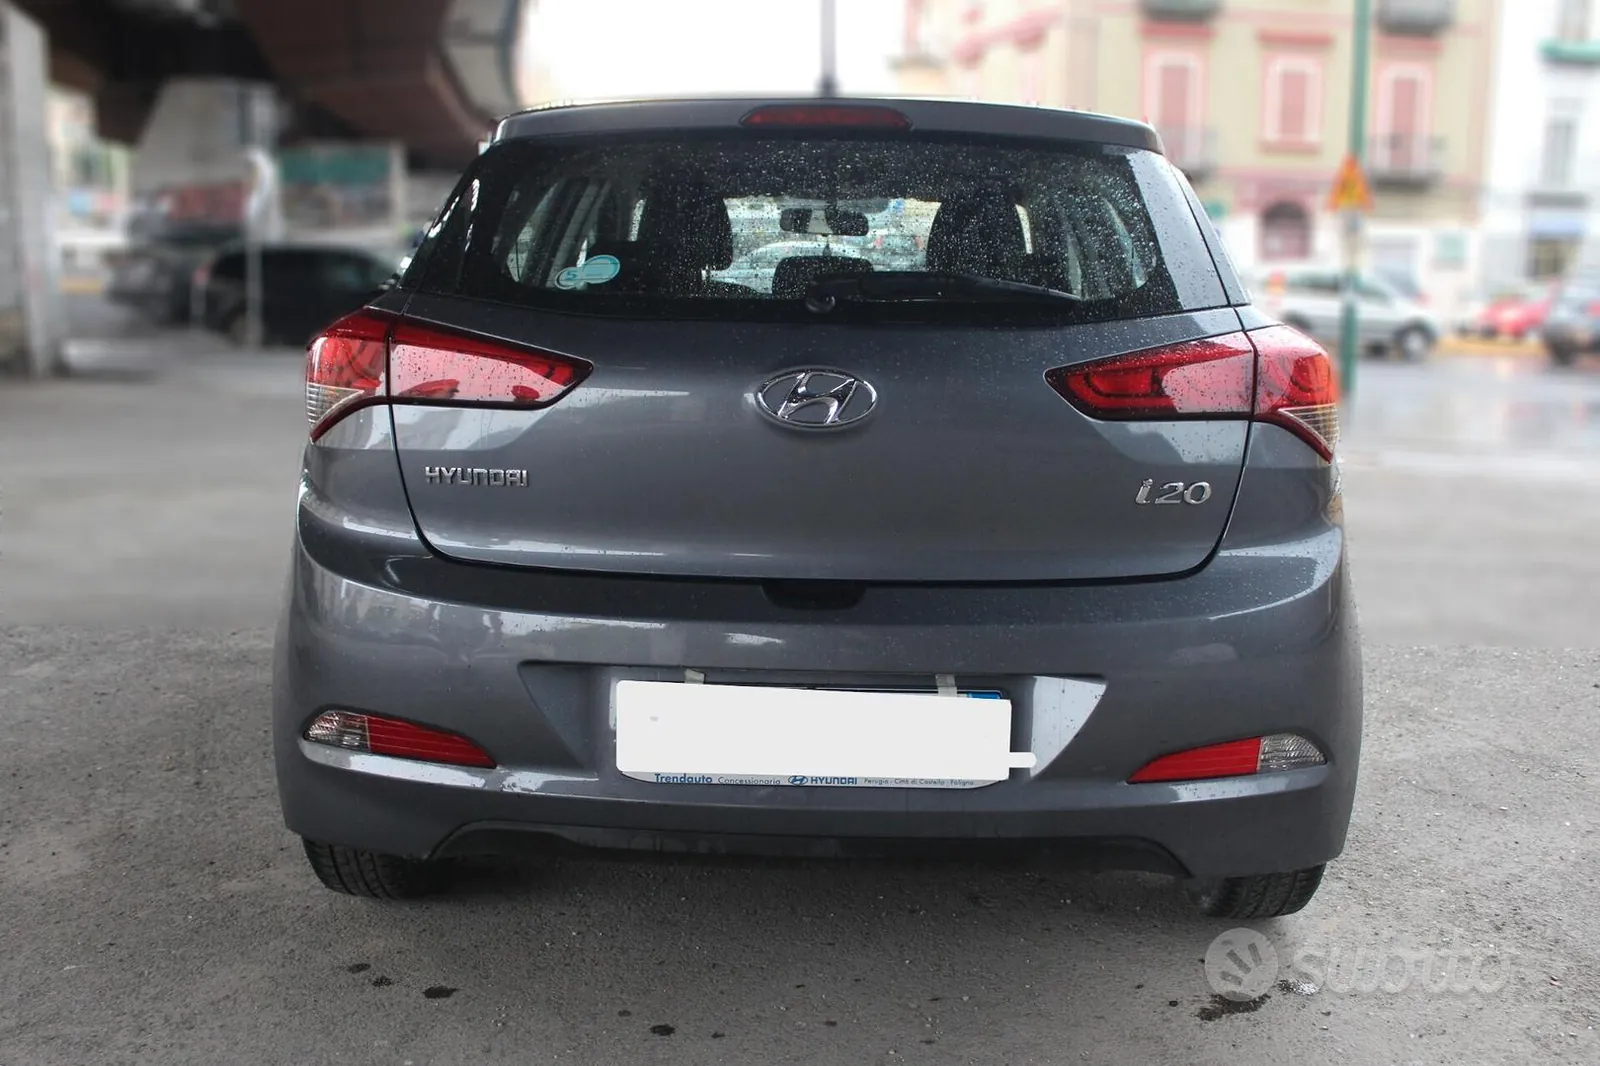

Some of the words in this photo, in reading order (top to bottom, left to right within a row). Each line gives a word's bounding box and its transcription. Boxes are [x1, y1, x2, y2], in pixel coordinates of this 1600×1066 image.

[424, 465, 529, 488] HYUNDAI
[1135, 478, 1212, 505] i20
[654, 773, 713, 785] Trendauto
[717, 776, 781, 786] Concessionaria
[810, 776, 858, 786] HYUNDAI
